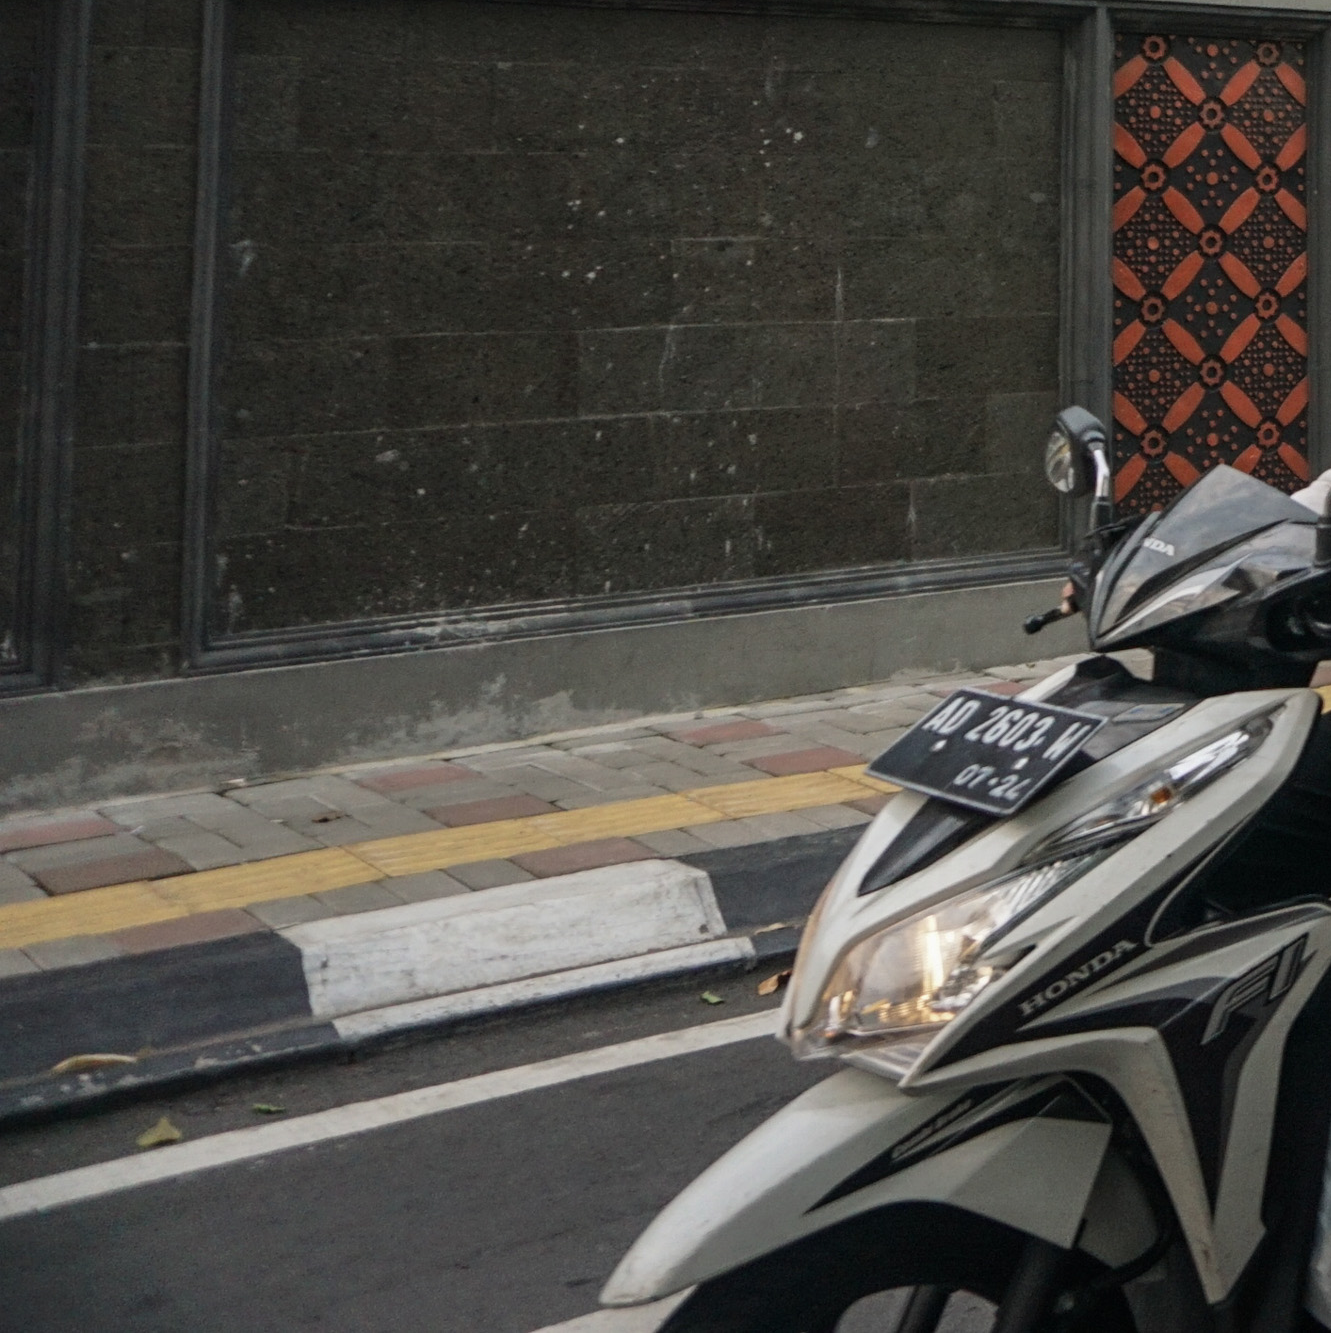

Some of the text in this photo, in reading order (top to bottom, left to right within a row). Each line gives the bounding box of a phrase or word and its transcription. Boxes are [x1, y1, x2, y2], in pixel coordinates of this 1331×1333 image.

[921, 696, 982, 735] AD
[963, 705, 1056, 752] 2603
[1017, 939, 1140, 1017] HONDA
